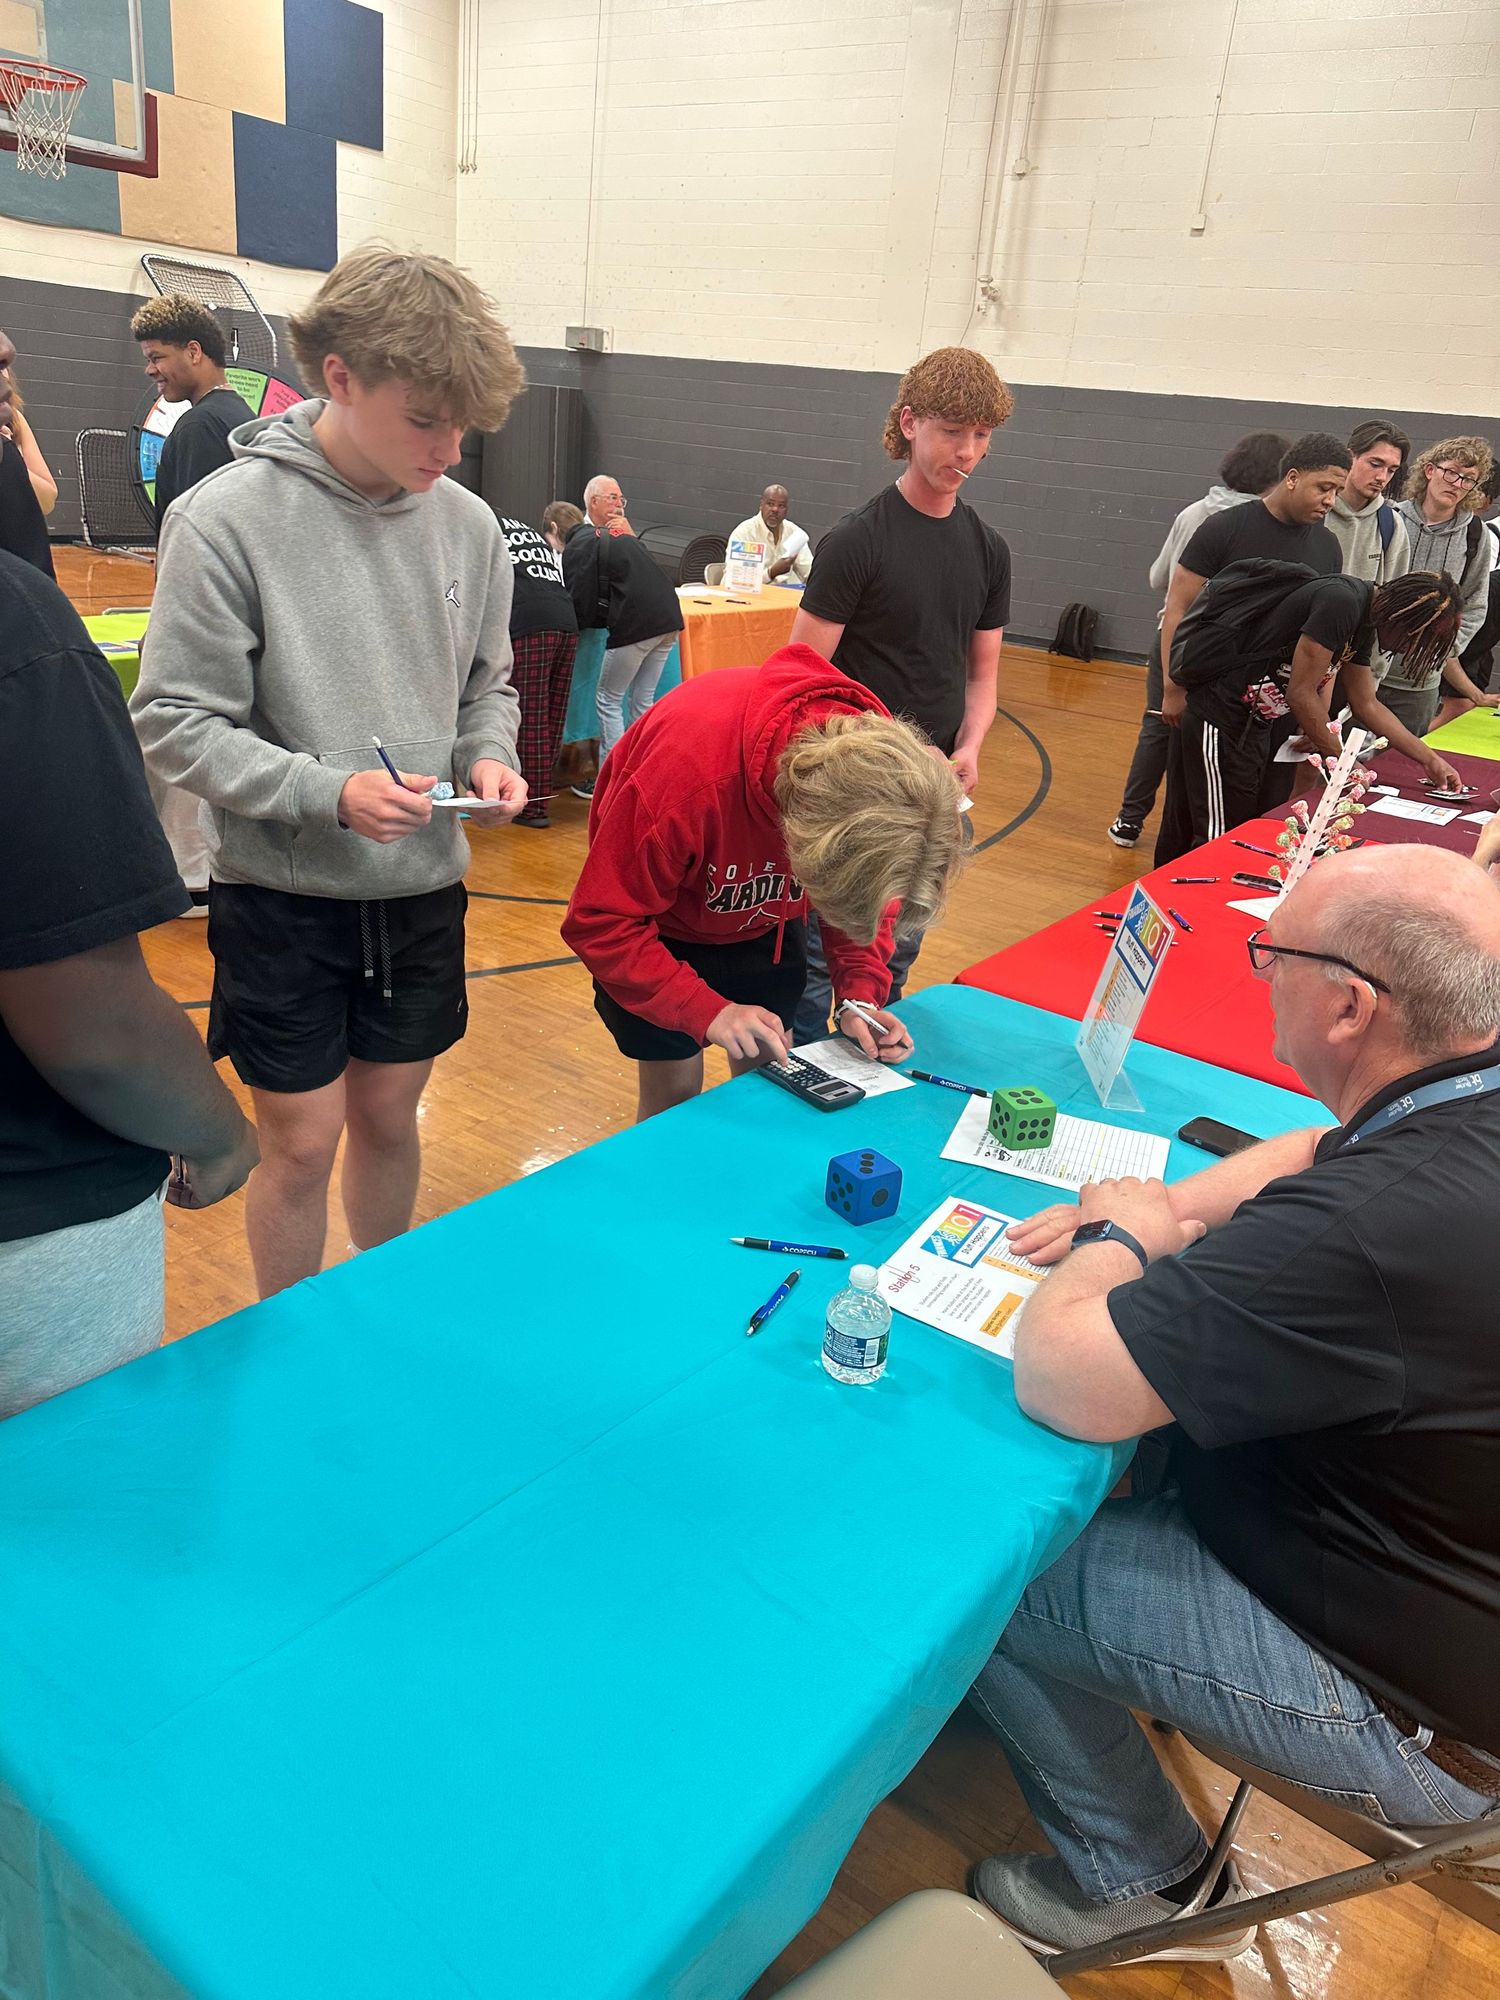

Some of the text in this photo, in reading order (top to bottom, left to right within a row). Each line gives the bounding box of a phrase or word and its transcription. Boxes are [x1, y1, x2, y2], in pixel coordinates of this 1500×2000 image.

[501, 518, 535, 531] AN
[503, 531, 548, 548] SOCIA
[1142, 912, 1167, 959] 101
[943, 1207, 980, 1235] 101
[970, 1225, 991, 1245] Happens
[888, 1269, 914, 1294] Station
[910, 1263, 921, 1276] 5
